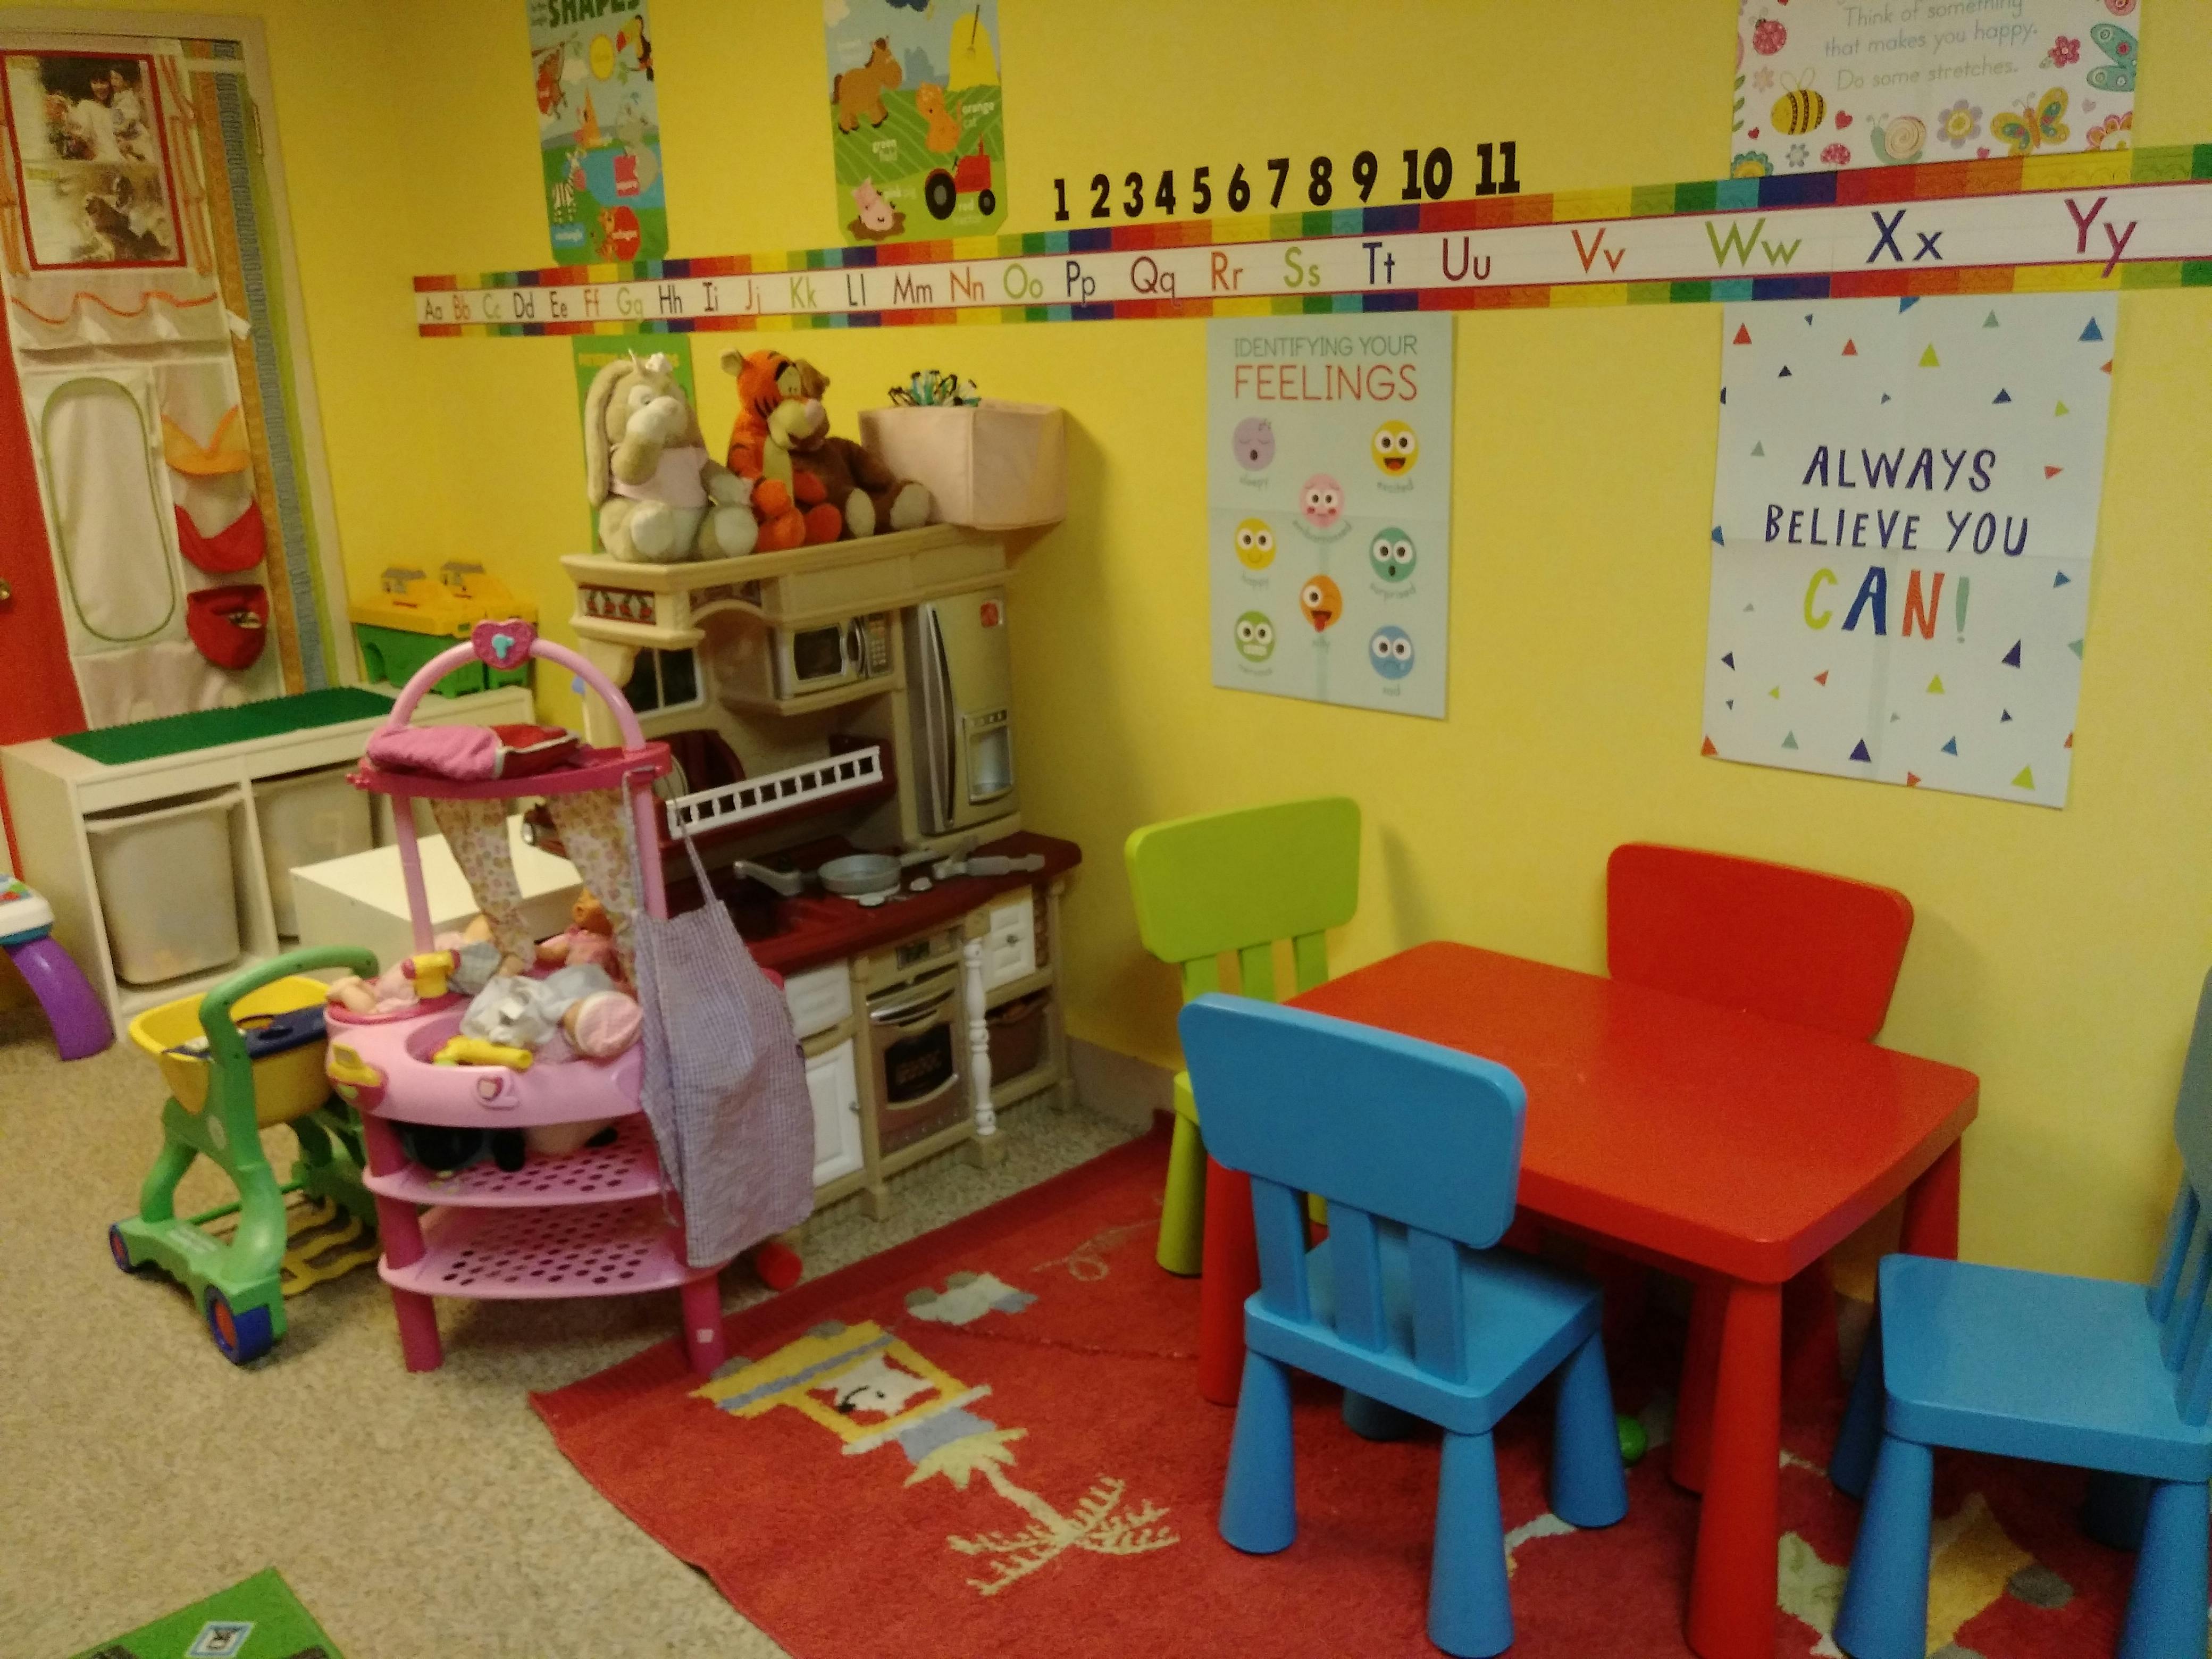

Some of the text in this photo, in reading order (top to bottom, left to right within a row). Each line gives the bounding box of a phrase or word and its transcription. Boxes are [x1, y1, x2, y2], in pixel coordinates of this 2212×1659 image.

[1844, 0, 2022, 27] Think of something
[1825, 19, 2038, 56] that makes you happy.
[1837, 56, 2019, 91] Do some stretches.
[962, 102, 994, 115] orange
[873, 139, 897, 153] green
[1054, 141, 1521, 221] 1 2 3 4 5 6 7 8 9 10 11
[425, 196, 2138, 320] Aa Bb Cc Dd Ee Ff Gg Hh Ii Jj Kk Ll Mm Nn Oo Pp Qq Rr Ss Tt Uu Vv Ww Xx Yy
[1235, 335, 1418, 358] IDENTIFYING YOUR
[1234, 364, 1418, 401] FEELINGS
[1802, 445, 1996, 492] ALWAYS
[1765, 504, 2029, 556] BELIEVE YOU
[1803, 566, 1970, 643] CAN!
